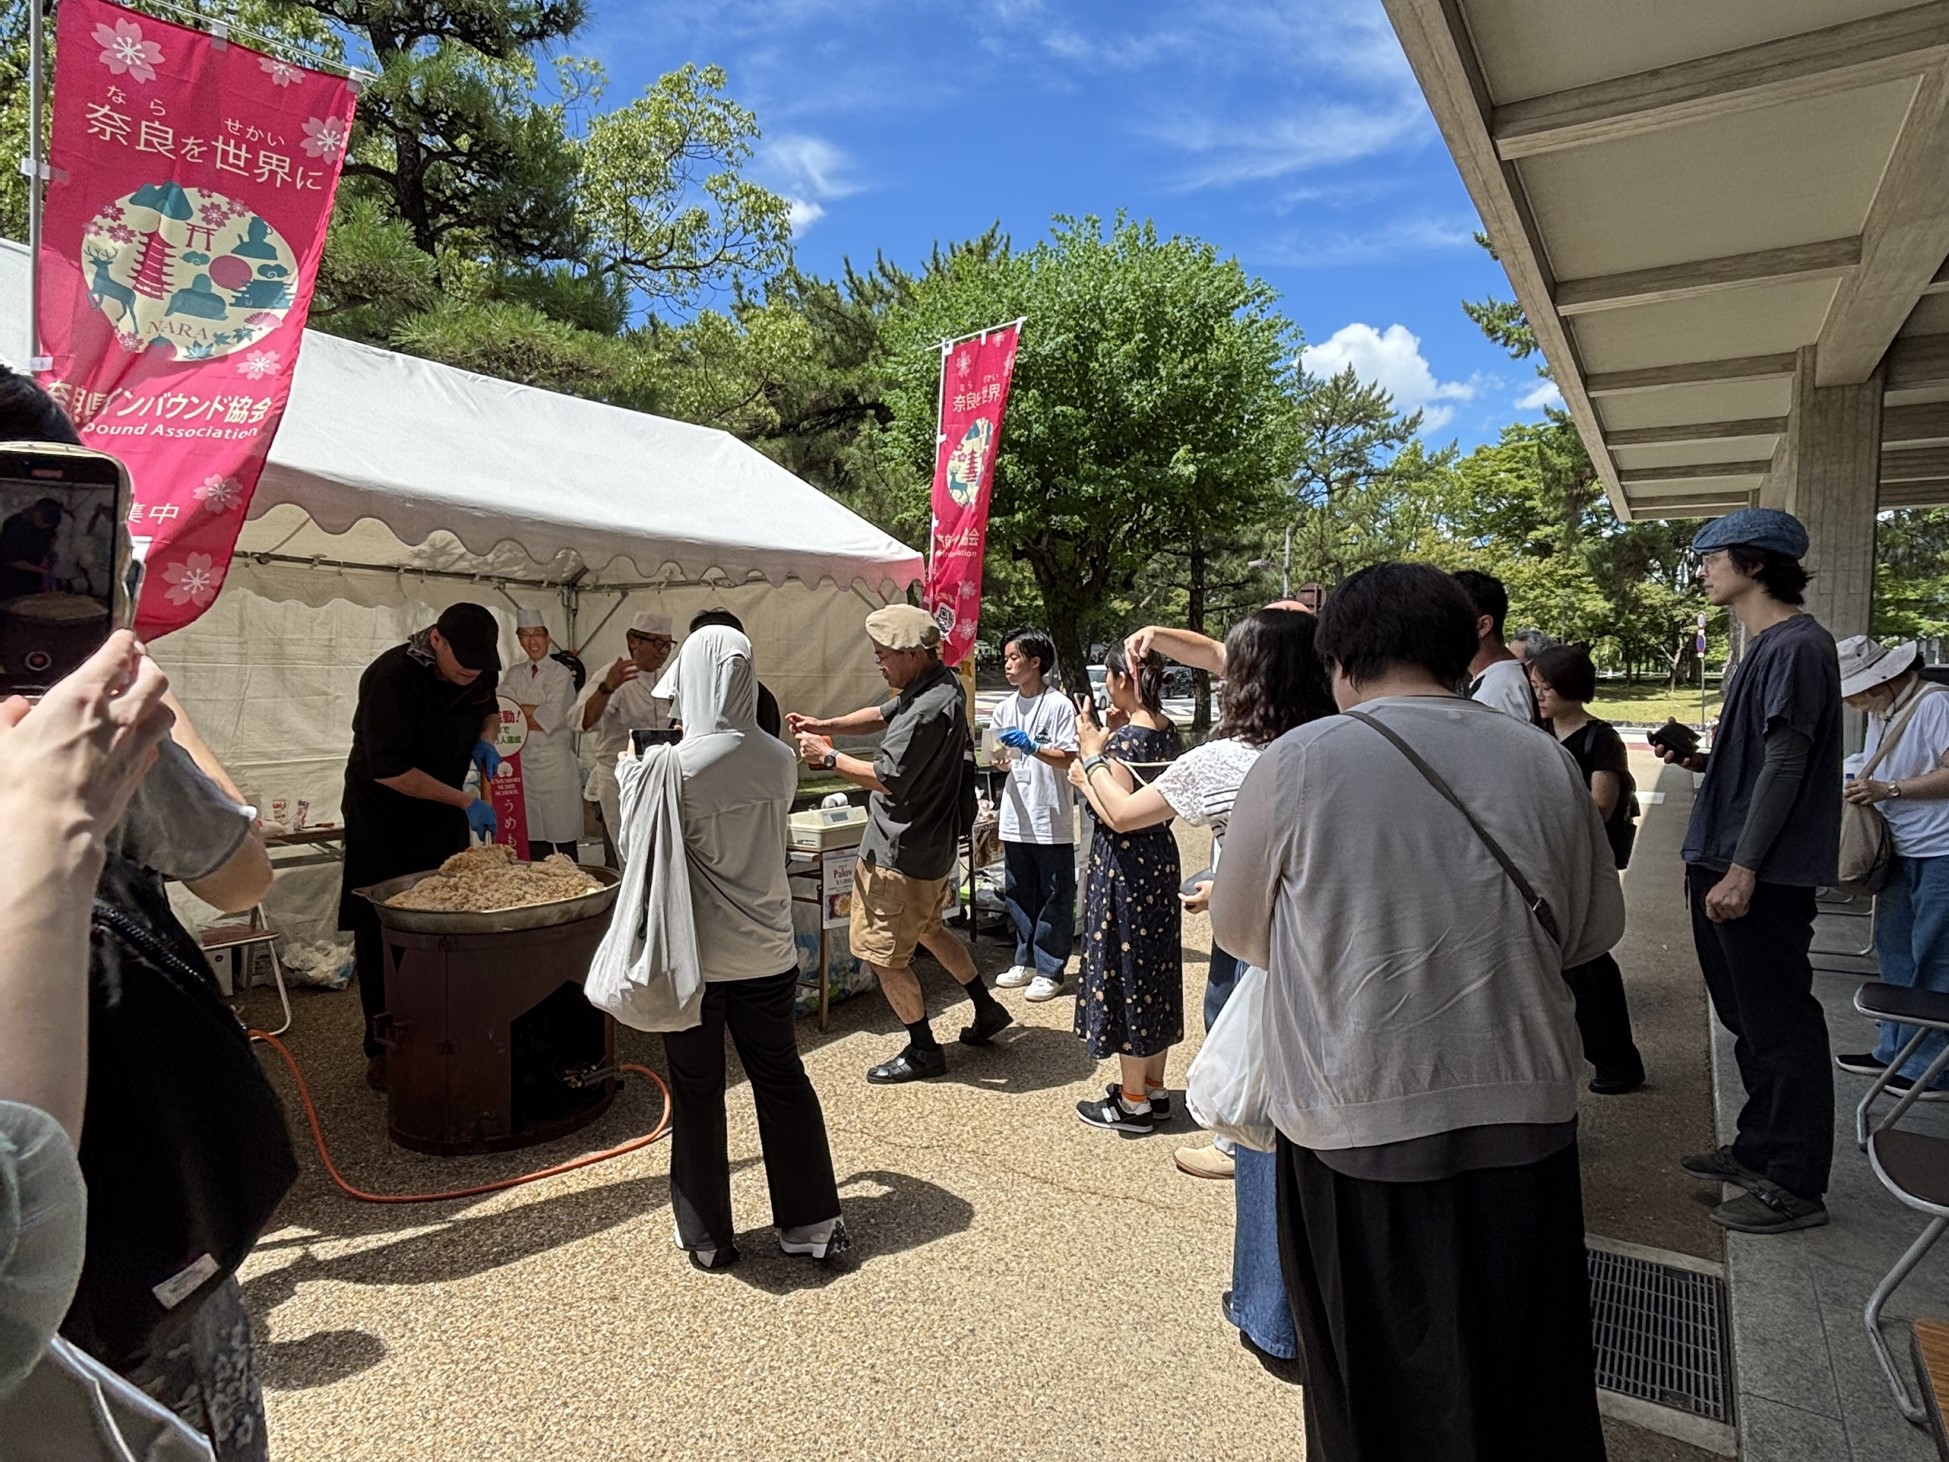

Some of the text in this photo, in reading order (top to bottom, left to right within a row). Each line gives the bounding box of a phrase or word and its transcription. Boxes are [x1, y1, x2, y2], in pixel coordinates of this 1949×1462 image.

[224, 118, 285, 147] せかい
[85, 102, 323, 190] 奈良を世界に
[146, 320, 209, 340] NARA
[151, 425, 258, 440] Association
